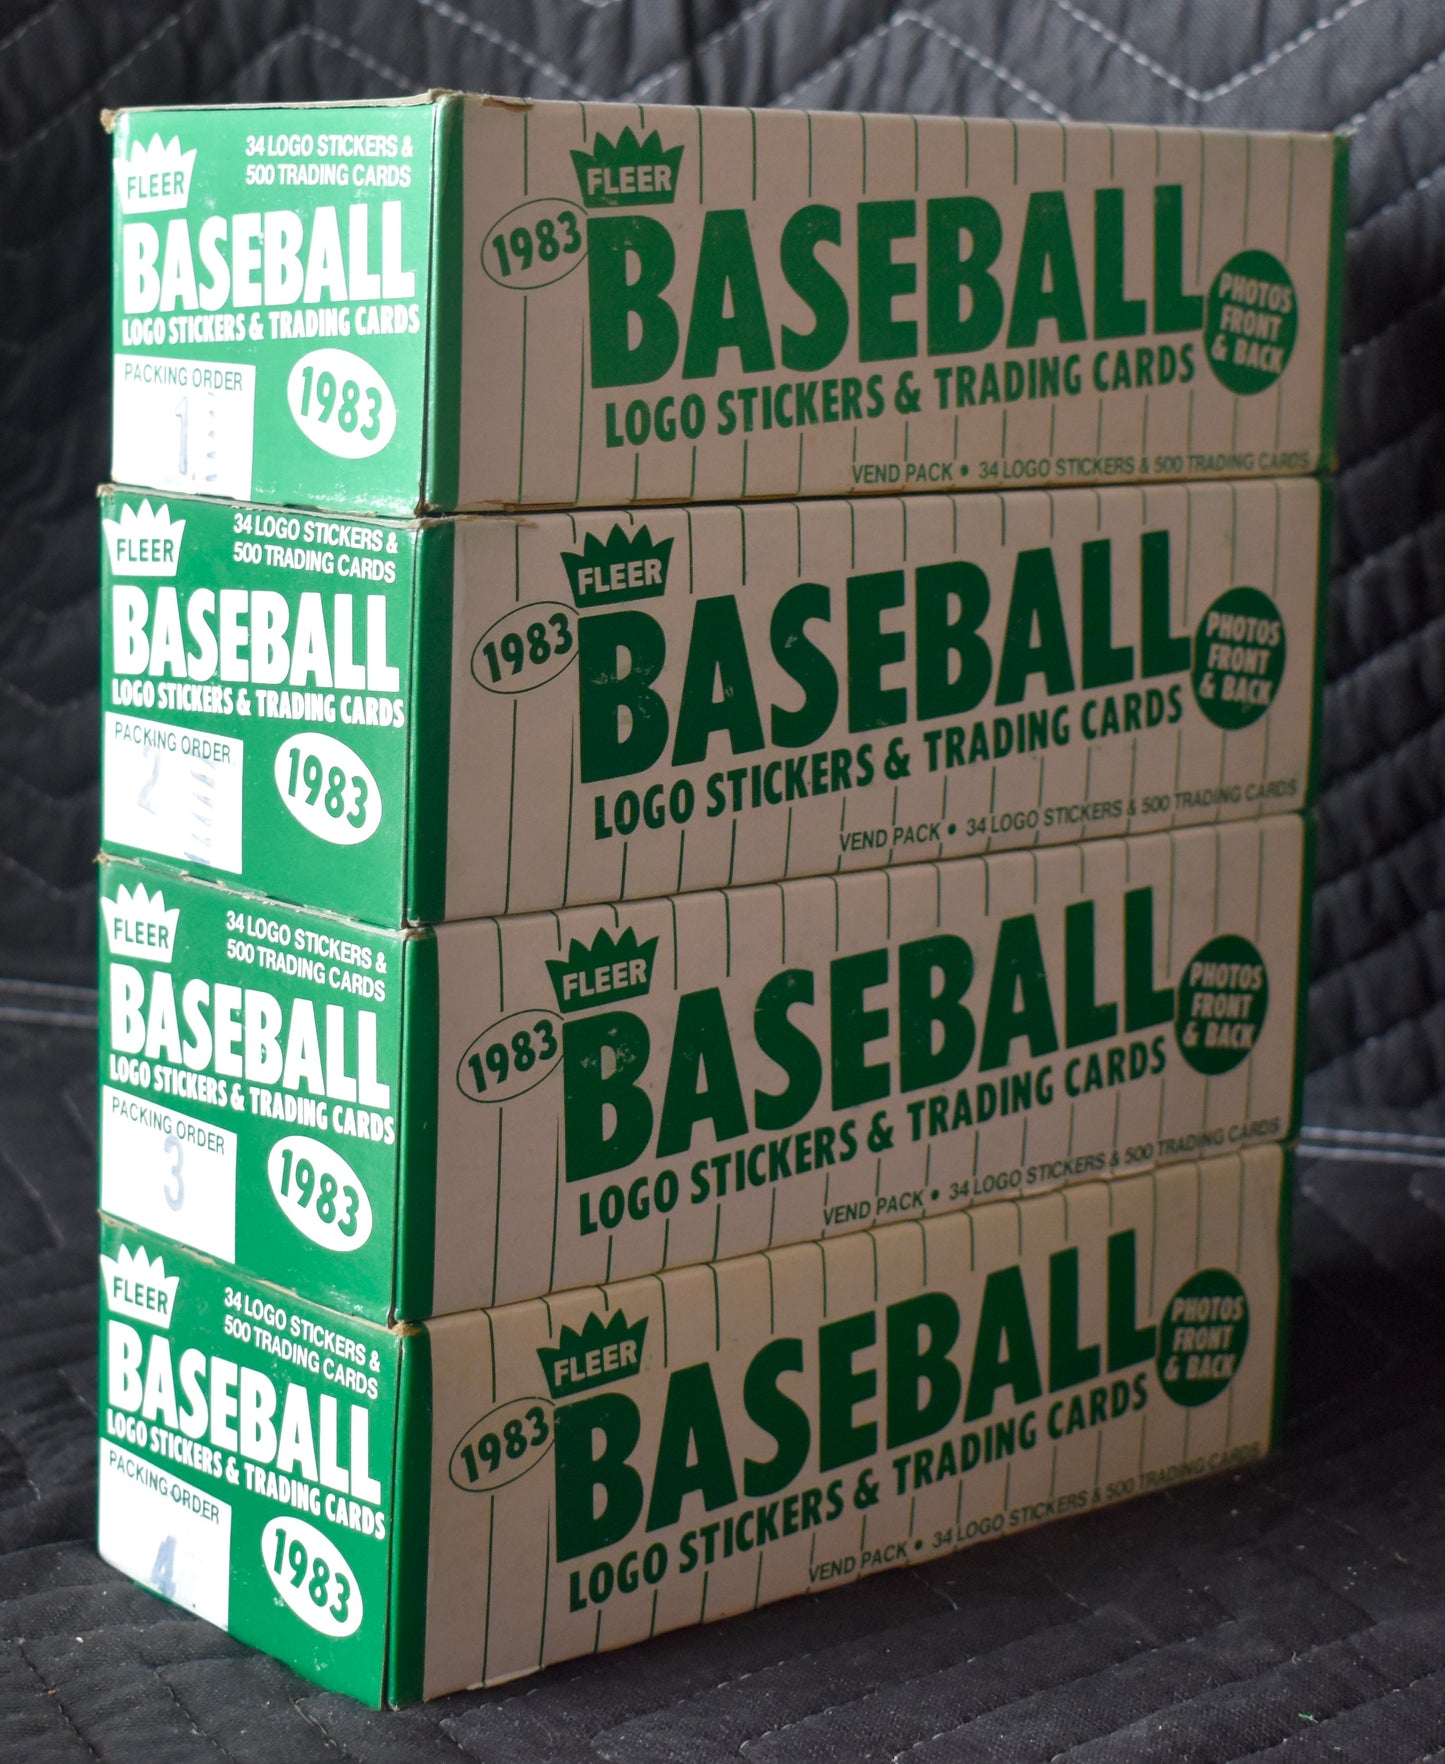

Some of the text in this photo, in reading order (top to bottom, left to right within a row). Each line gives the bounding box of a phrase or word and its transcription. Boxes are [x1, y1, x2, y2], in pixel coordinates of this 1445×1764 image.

[246, 135, 413, 158] 34 LOGO STICKERS &
[246, 164, 411, 187] 500 TRADING CARDS
[127, 171, 184, 200] FLEER
[587, 165, 672, 195] FLEER
[123, 201, 416, 314] BASEBALL
[492, 211, 582, 277] 1983
[586, 184, 1203, 389] BASEBALL
[1218, 272, 1292, 314] PHOTOS
[122, 304, 420, 346] LOGO STICKERS & TRADING CARDS
[1220, 303, 1282, 340] FRONT
[125, 363, 242, 391] PACKING ORDER
[1211, 336, 1284, 373] & BACK
[301, 366, 383, 441] 1983
[605, 342, 1195, 448] LOGO STICKERS & TRADING CARDS
[853, 465, 899, 484] VEND
[905, 462, 953, 482] PACK
[979, 461, 998, 479] 34
[1003, 460, 1050, 479] LOGO
[1055, 457, 1135, 476] STICKERS
[1154, 456, 1183, 474] 500
[117, 539, 174, 563] FLEER
[233, 512, 398, 554] 34 LOGO STICKERS &
[233, 542, 396, 583] 500 TRADING CARDS
[578, 558, 662, 596] FLEER
[112, 585, 400, 693] BASEBALL
[482, 613, 573, 684] 1983
[577, 529, 1191, 784] BASEBALL
[1206, 611, 1281, 644] PHOTOS
[1208, 643, 1270, 675] FRONT
[112, 678, 405, 728] LOGO STICKERS & TRADING CARDS
[1199, 672, 1272, 706] & BACK
[115, 721, 231, 763] PACKING ORDER
[595, 684, 1183, 840] LOGO STICKERS & TRADING CARDS
[288, 748, 368, 829] 1983
[839, 830, 887, 852] VEND
[893, 823, 941, 846] PACK
[966, 818, 986, 836] 34
[990, 811, 1038, 834] LOGO
[1043, 798, 1122, 827] STICKERS
[1142, 794, 1170, 815] 500
[114, 917, 168, 949] FLEER
[225, 910, 387, 974] 34 LOGO STICKERS &
[226, 941, 386, 1001] 500 TRADING CARDS
[563, 958, 647, 1000] FLEER
[1189, 961, 1262, 989] PHOTOS
[562, 885, 1175, 1184] BASEBALL
[1191, 993, 1253, 1019] FRONT
[110, 962, 390, 1109] BASEBALL
[468, 1019, 558, 1094] 1983
[1182, 1022, 1254, 1049] & BACK
[109, 1054, 394, 1145] LOGO STICKERS & TRADING CARDS
[112, 1096, 224, 1154] PACKING ORDER
[580, 1035, 1167, 1236] LOGO STICKERS & TRADING CARDS
[163, 1136, 184, 1211] 3
[281, 1148, 359, 1237] 1983
[823, 1203, 871, 1227] VEND
[876, 1190, 924, 1216] PACK
[949, 1181, 969, 1201] 34
[973, 1170, 1021, 1196] LOGO
[1026, 1153, 1105, 1186] STICKERS
[1125, 1144, 1154, 1164] 500
[113, 1276, 168, 1315] FLEER
[1170, 1295, 1243, 1324] PHOTOS
[224, 1286, 381, 1373] 34 LOGO STICKERS &
[224, 1317, 378, 1400] 500 TRADING CARDS
[1172, 1325, 1234, 1351] FRONT
[554, 1339, 637, 1387] FLEER
[1164, 1353, 1236, 1380] & BACK
[109, 1319, 382, 1506] BASEBALL
[554, 1228, 1157, 1564] BASEBALL
[460, 1406, 550, 1483] 1983
[107, 1408, 385, 1540] LOGO STICKERS & TRADING CARDS
[109, 1450, 219, 1525] PACKING ORDER
[570, 1372, 1148, 1613] LOGO STICKERS & TRADING CARDS
[809, 1556, 855, 1583] VEND
[861, 1541, 908, 1568] PACK
[932, 1528, 953, 1547] 34
[957, 1515, 1004, 1542] LOGO
[1009, 1493, 1089, 1527] STICKERS
[1106, 1480, 1135, 1501] 500
[273, 1528, 350, 1623] 1983
